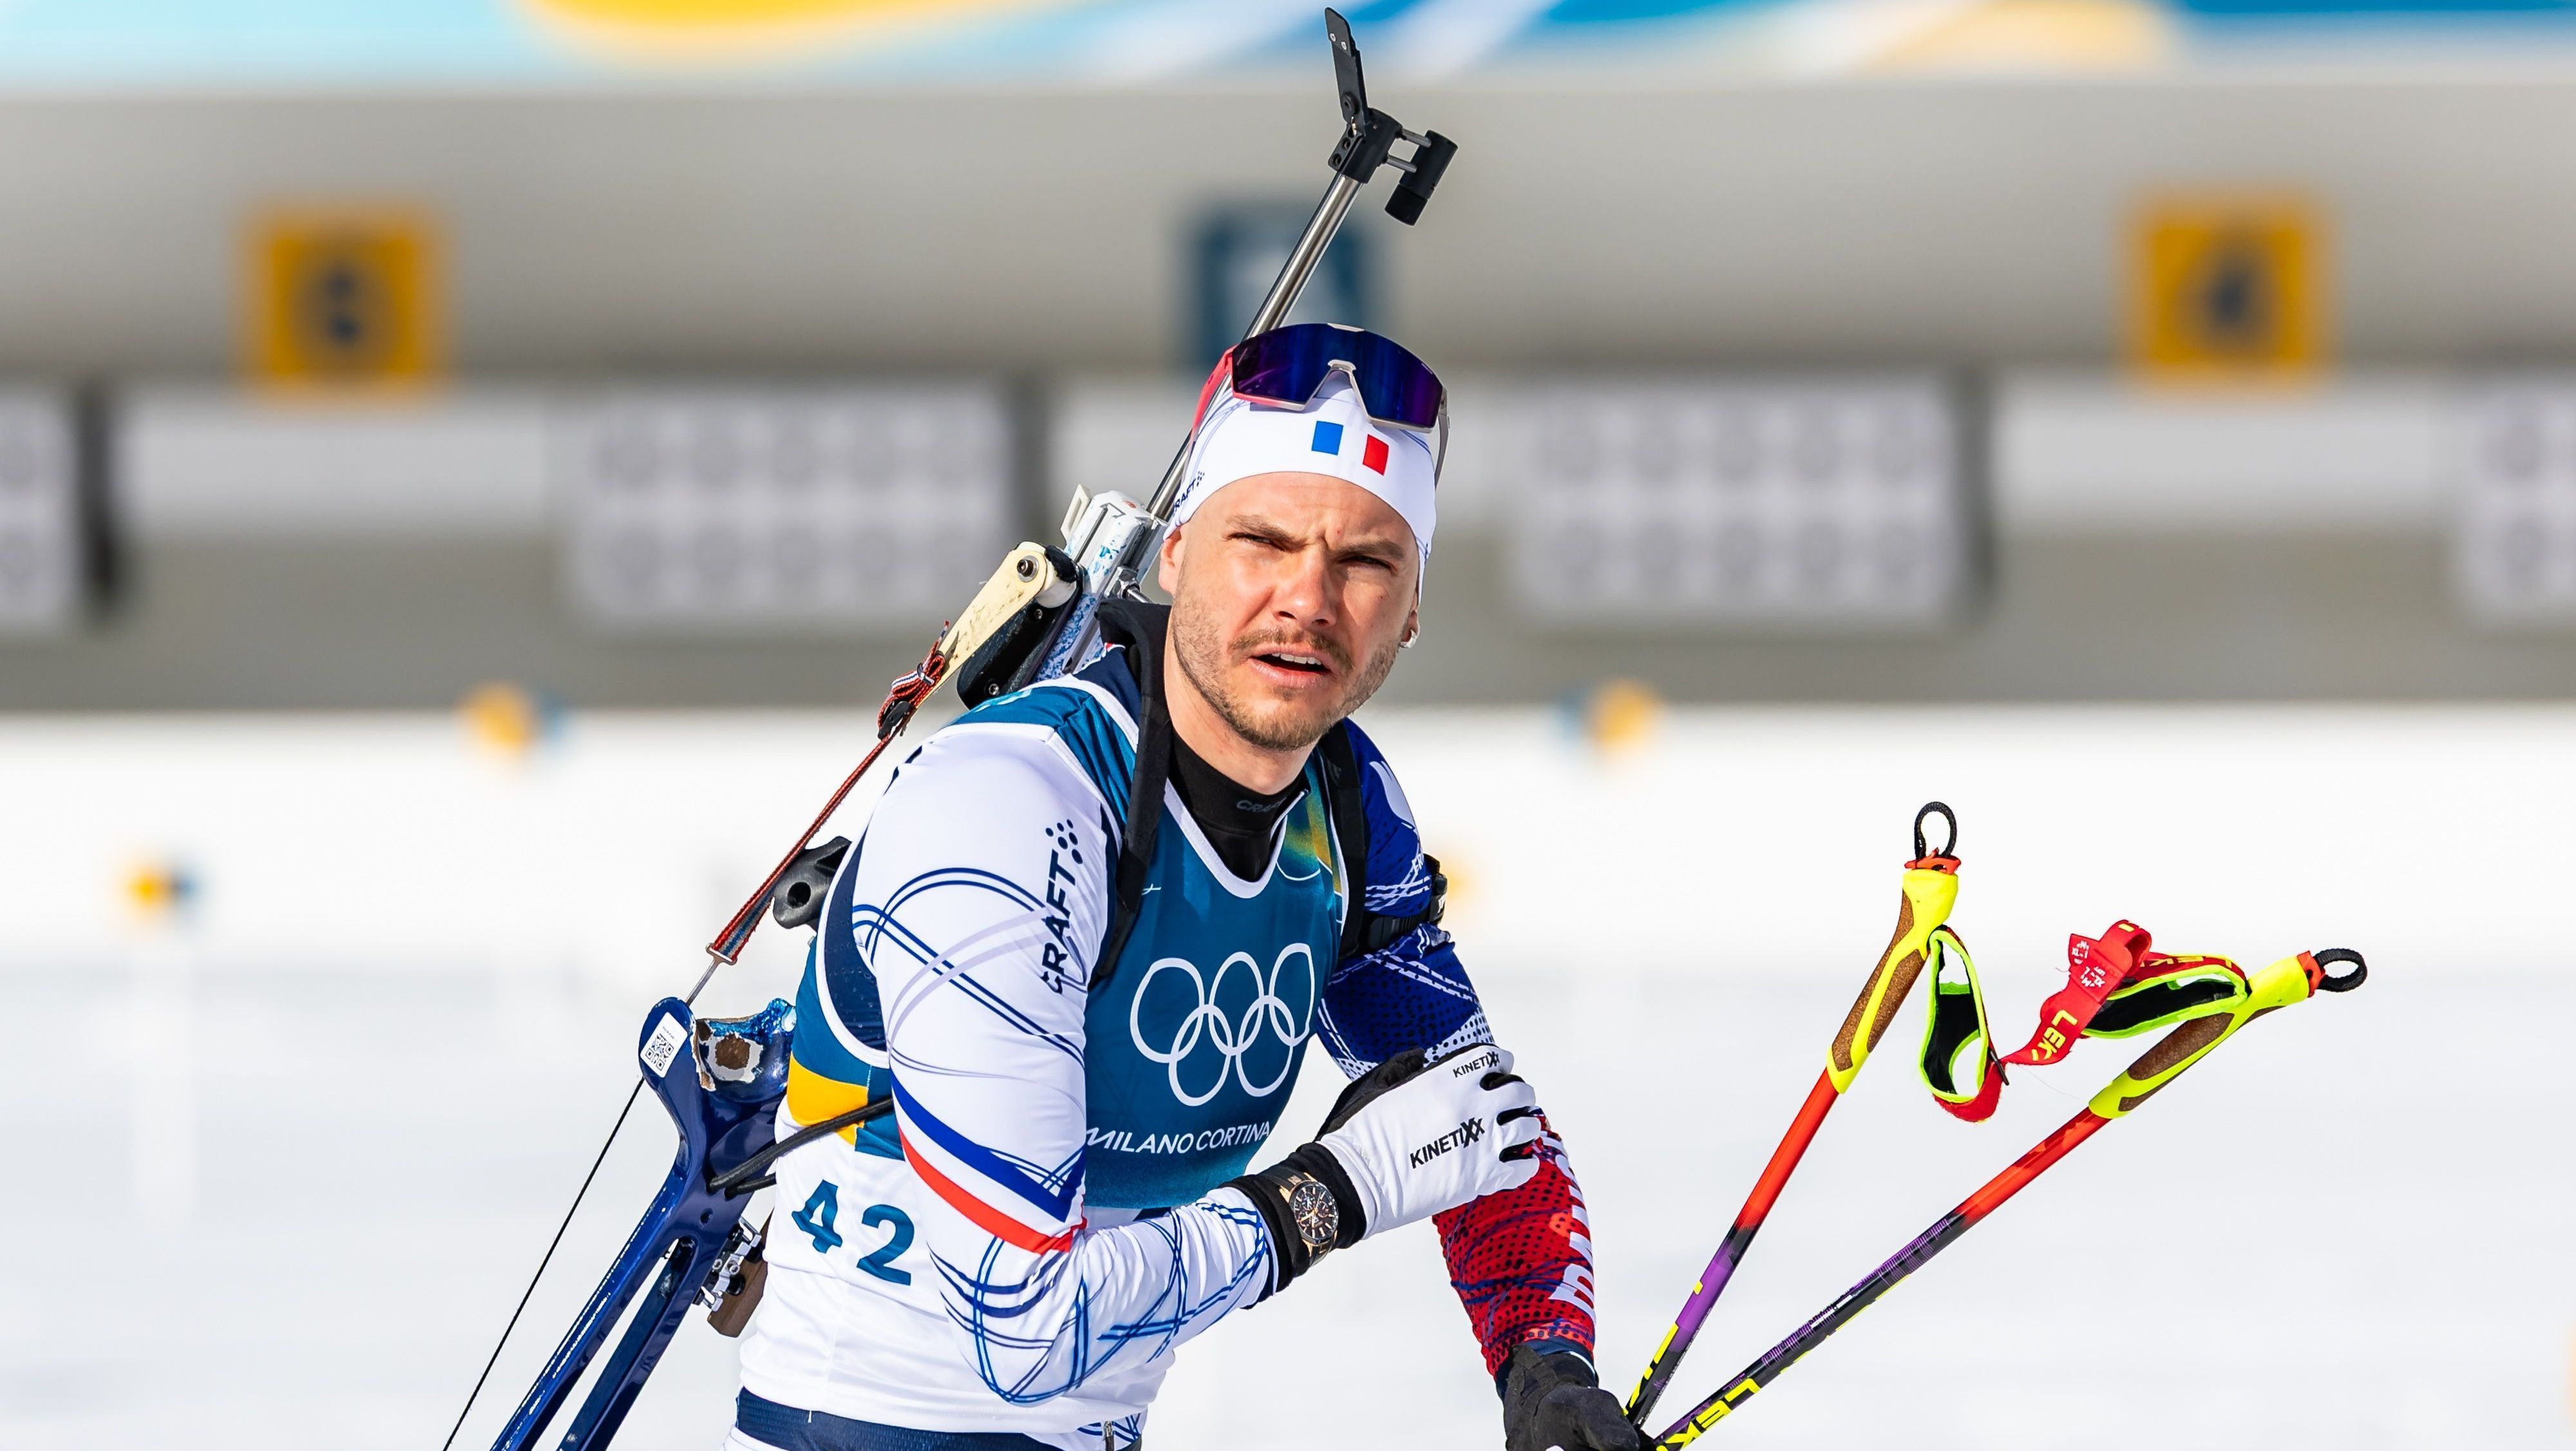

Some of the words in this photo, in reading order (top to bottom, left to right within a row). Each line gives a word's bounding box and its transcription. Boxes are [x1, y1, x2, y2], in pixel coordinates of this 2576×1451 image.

[1173, 479, 1196, 517] RAFT
[1041, 849, 1075, 994] CRAFT
[2031, 1009, 2078, 1061] LEKI
[1086, 1127, 1194, 1154] MILANO
[1196, 1121, 1270, 1151] CORTINA
[791, 1179, 914, 1286] 42
[1656, 1378, 1761, 1451] LEK
